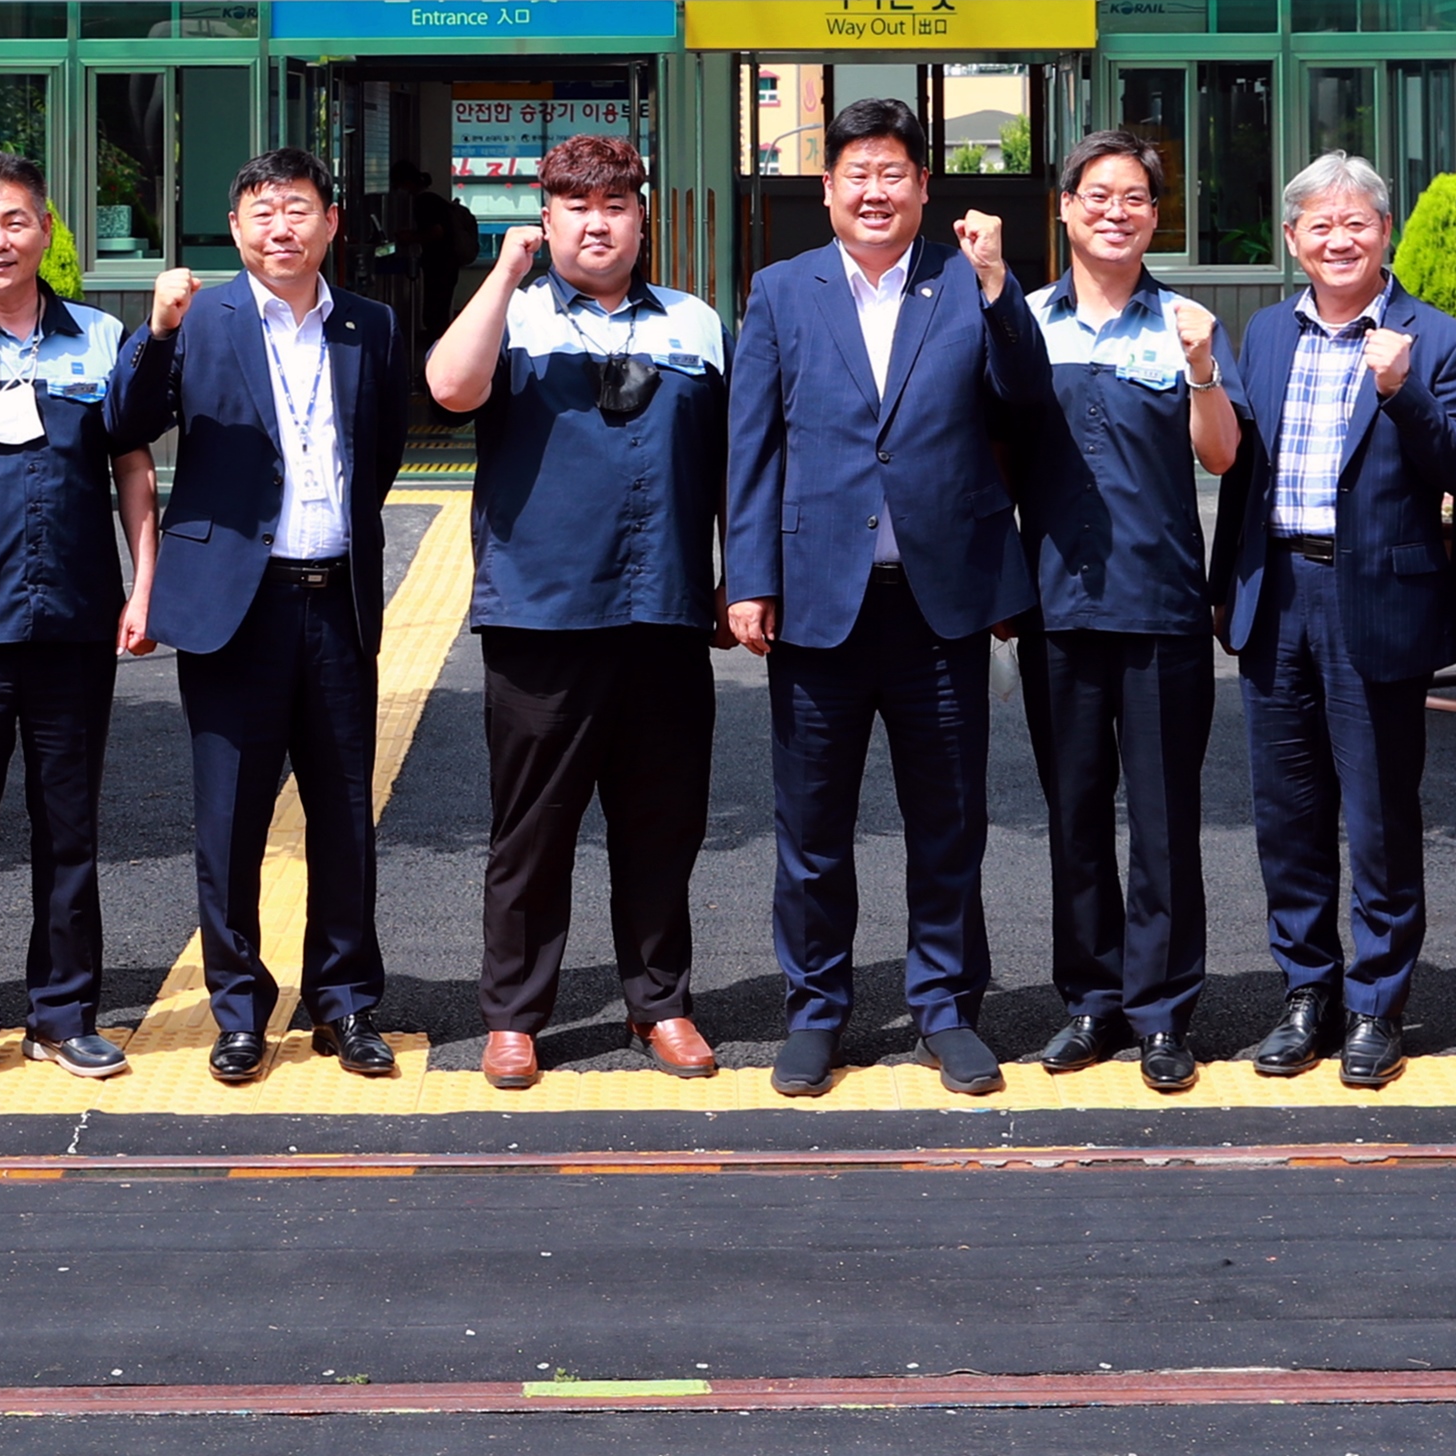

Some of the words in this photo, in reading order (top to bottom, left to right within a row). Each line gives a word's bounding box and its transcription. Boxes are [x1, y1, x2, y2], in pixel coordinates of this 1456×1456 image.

[411, 8, 488, 26] Entrance
[497, 8, 531, 25] 入口
[1109, 1, 1166, 16] KORAIL
[826, 18, 866, 39] Way
[870, 17, 906, 36] Out
[917, 18, 948, 36] 出口
[455, 102, 513, 124] 안전한
[518, 102, 575, 124] 승강기
